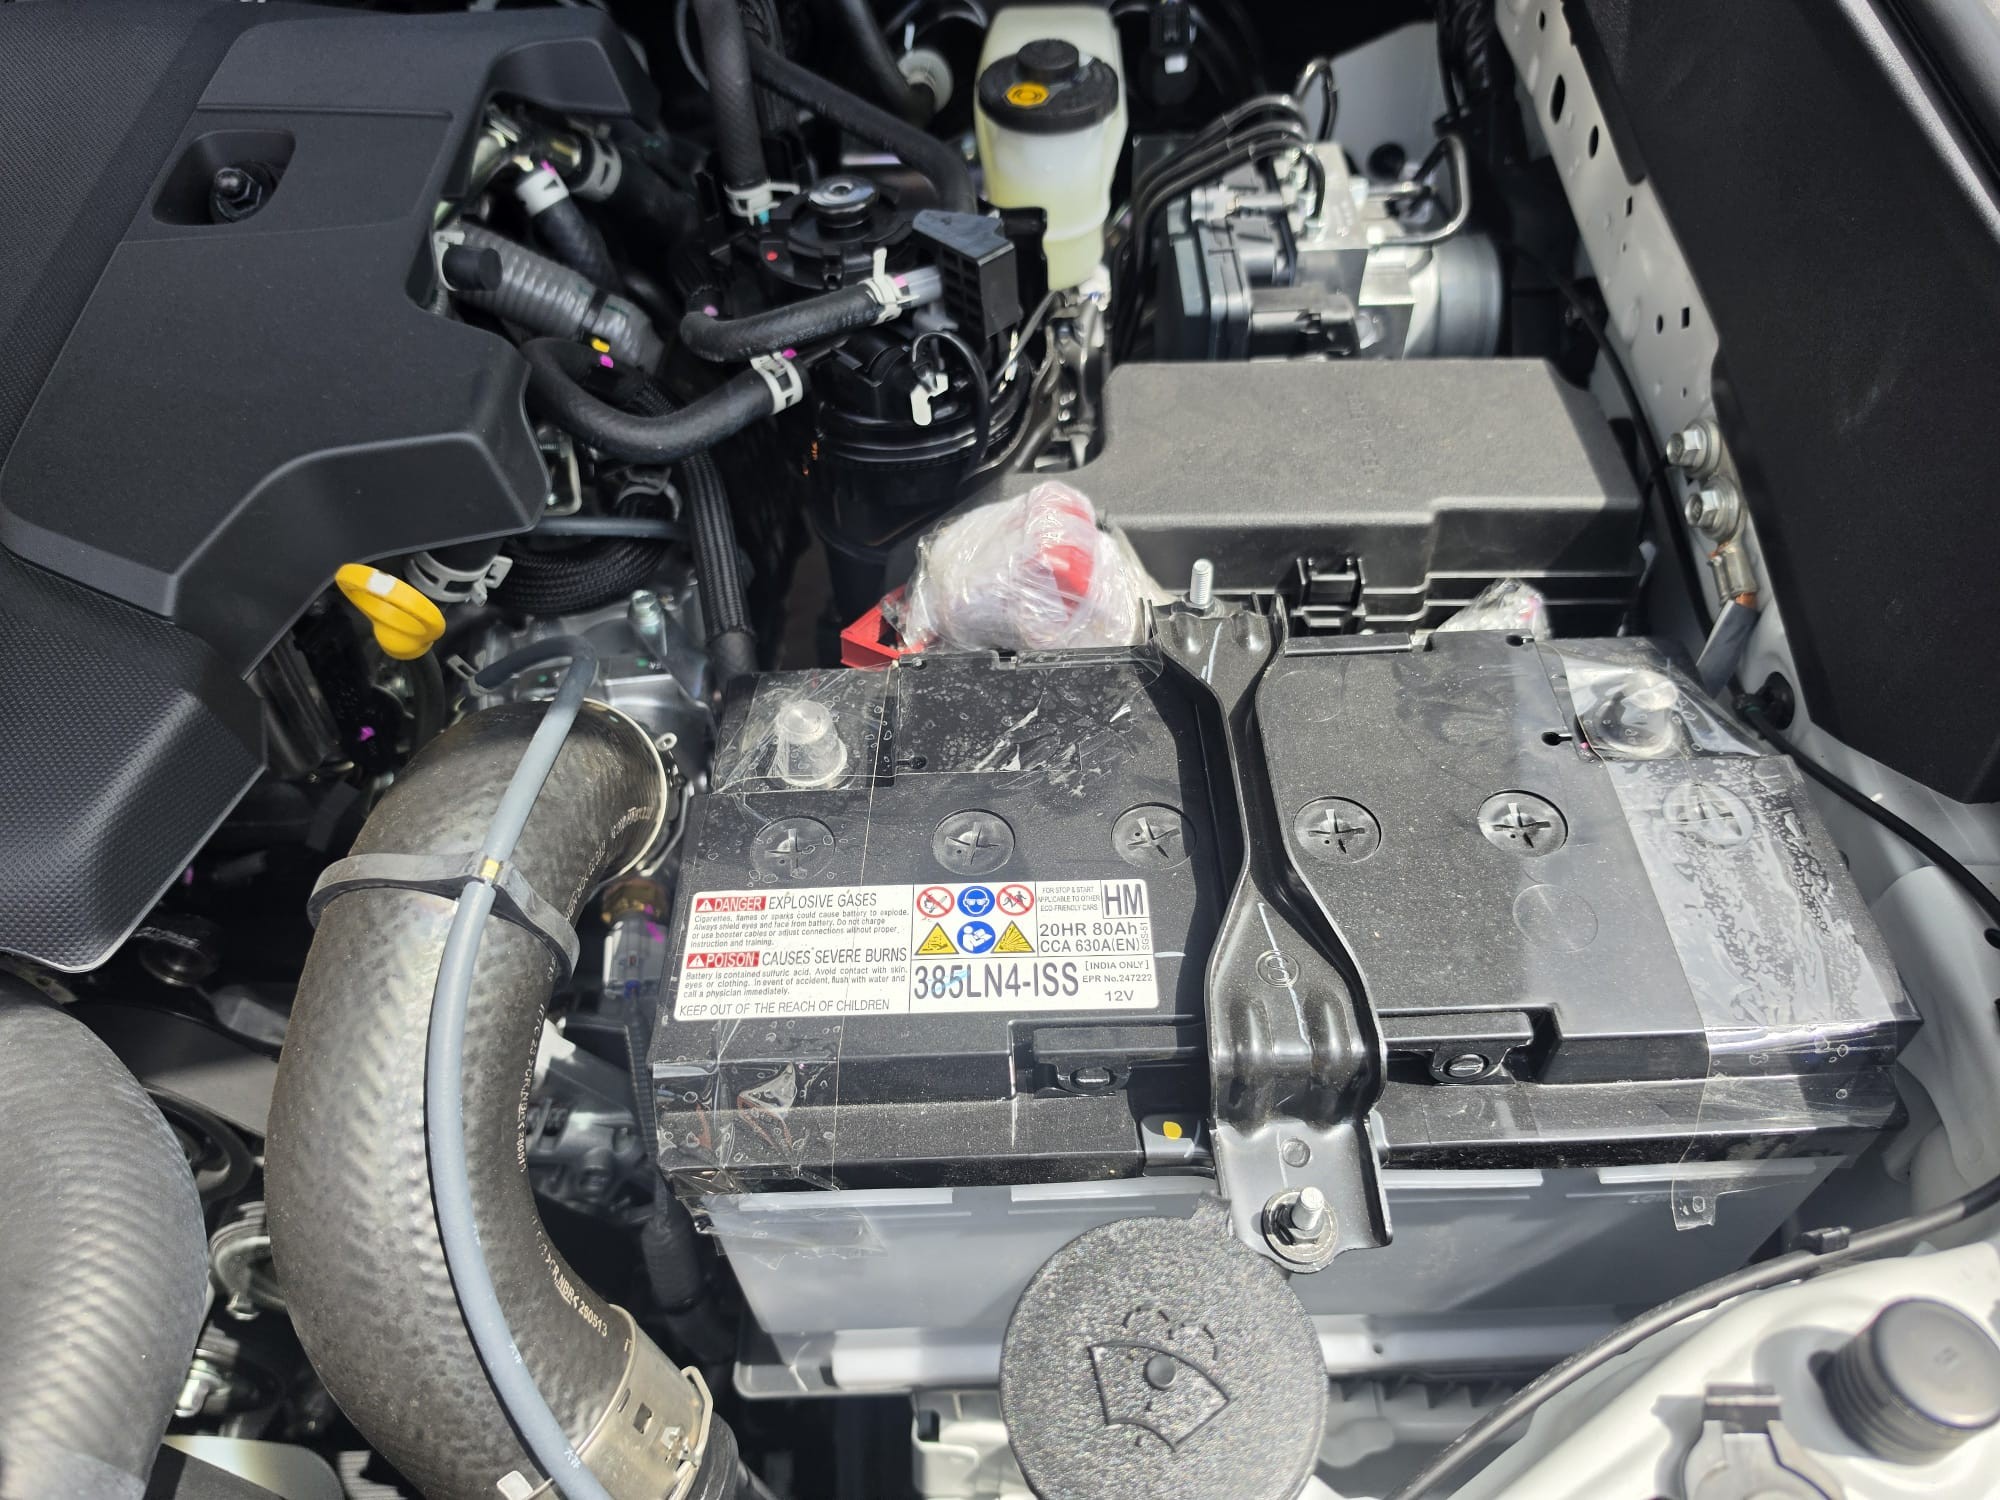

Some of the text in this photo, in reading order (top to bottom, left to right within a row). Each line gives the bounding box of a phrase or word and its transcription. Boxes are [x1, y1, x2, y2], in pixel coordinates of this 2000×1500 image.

[714, 893, 876, 912] DANGER EXPLOSIVE GASES
[1104, 884, 1144, 916] HM
[771, 912, 794, 920] sparks
[842, 910, 867, 918] battery
[694, 923, 718, 931] Always
[862, 918, 886, 926] charge
[1040, 922, 1138, 936] 20HR 80Ah
[802, 928, 844, 936] connections
[746, 939, 774, 947] training.
[1040, 938, 1140, 952] CCA 630A(EN)
[706, 948, 907, 968] POISON CAUSES SEVERE BURNS
[686, 972, 713, 980] Battery
[724, 970, 760, 978] contained
[762, 969, 790, 977] sulfuric
[814, 967, 836, 975] Avoid
[1082, 975, 1101, 983] EPR
[684, 982, 702, 990] eyes
[914, 962, 1079, 1000] 385LN4-ISS
[706, 989, 742, 998] physician
[1104, 990, 1134, 1002] 12V
[680, 999, 890, 1016] KEEP OUT OF THE REACH OF CHILDREN
